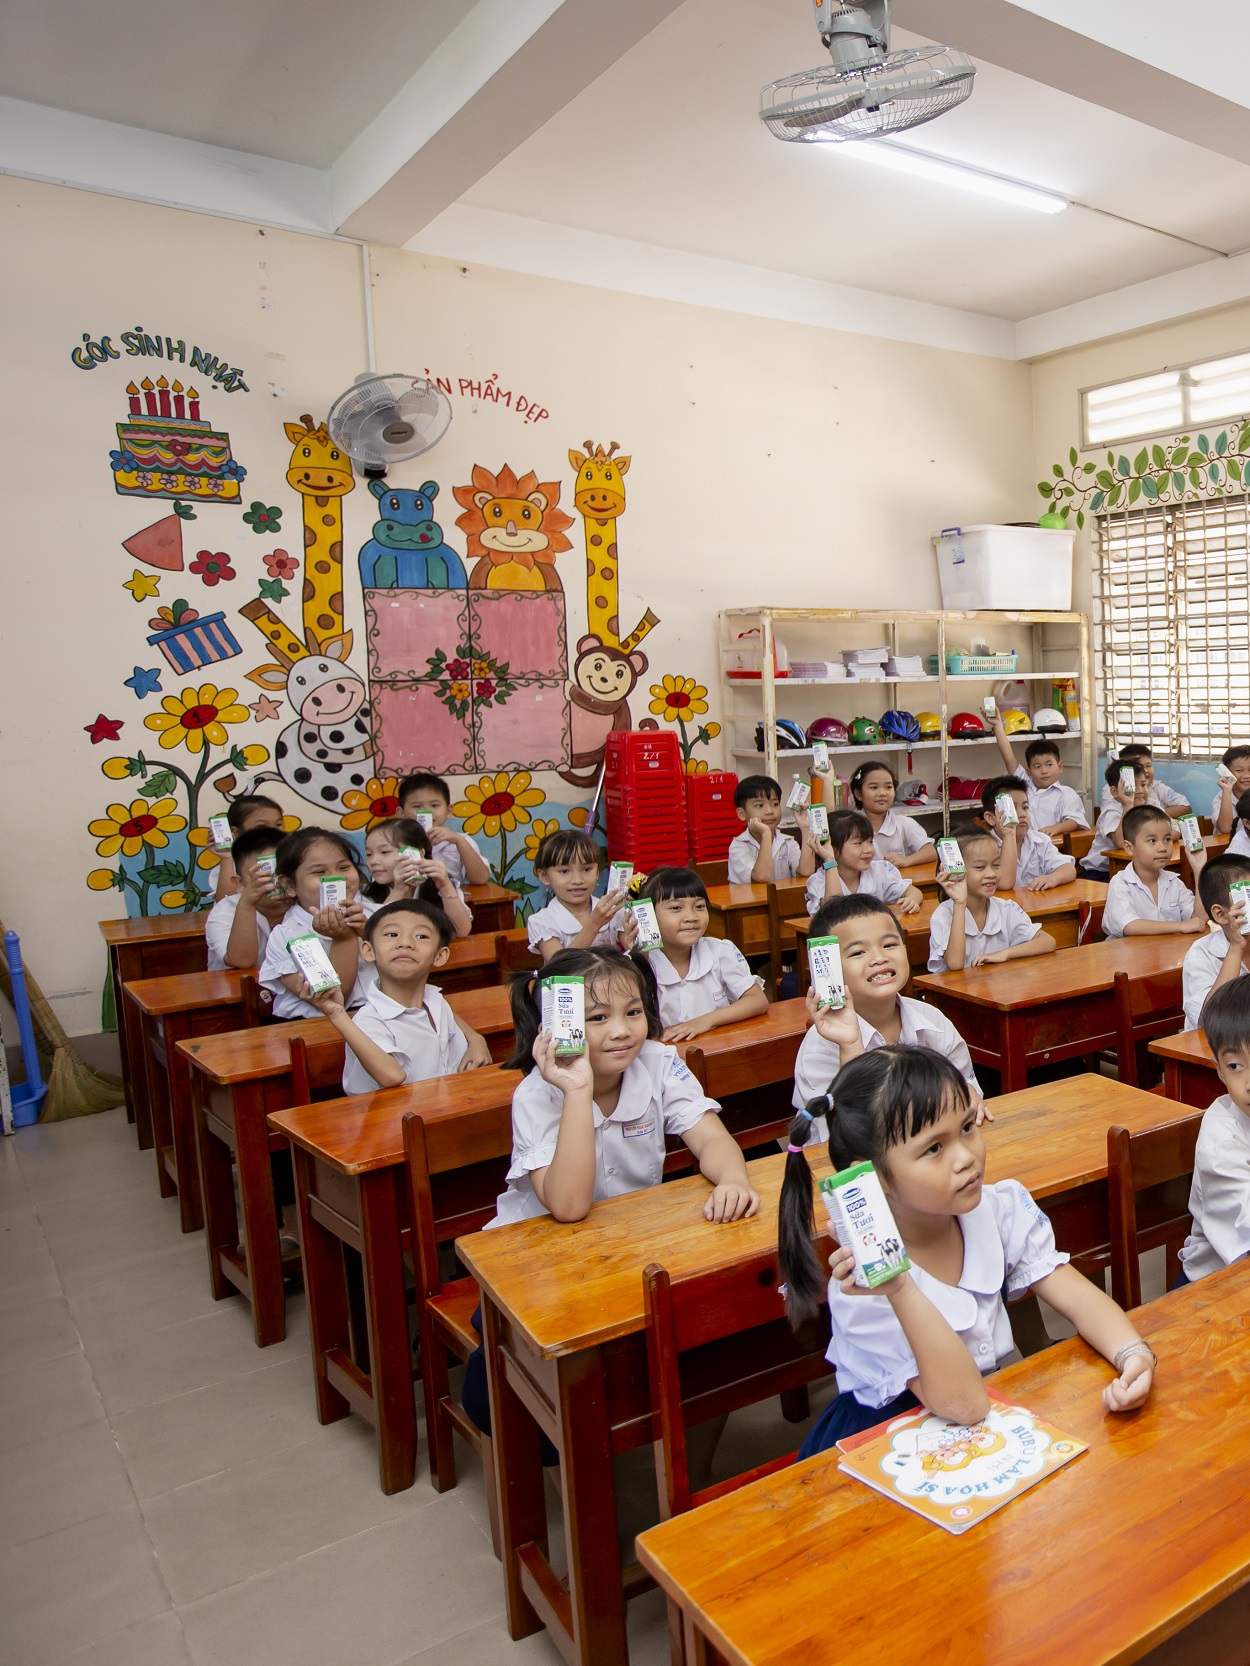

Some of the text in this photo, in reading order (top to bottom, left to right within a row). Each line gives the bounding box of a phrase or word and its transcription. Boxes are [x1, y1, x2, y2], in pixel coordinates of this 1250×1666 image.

[71, 326, 250, 393] GÓC SINH NHẬT
[459, 373, 512, 407] PHẨM
[515, 395, 549, 424] ĐẸP
[643, 752, 659, 760] 2/1
[380, 801, 389, 812] 2
[133, 821, 144, 832] 5
[847, 1198, 866, 1212] 100%
[850, 1211, 865, 1221] Sữa
[852, 1213, 875, 1229] Tươi
[1011, 1425, 1036, 1455] BUBU
[993, 1458, 1031, 1484] LÀM
[945, 1481, 990, 1495] HỌA
